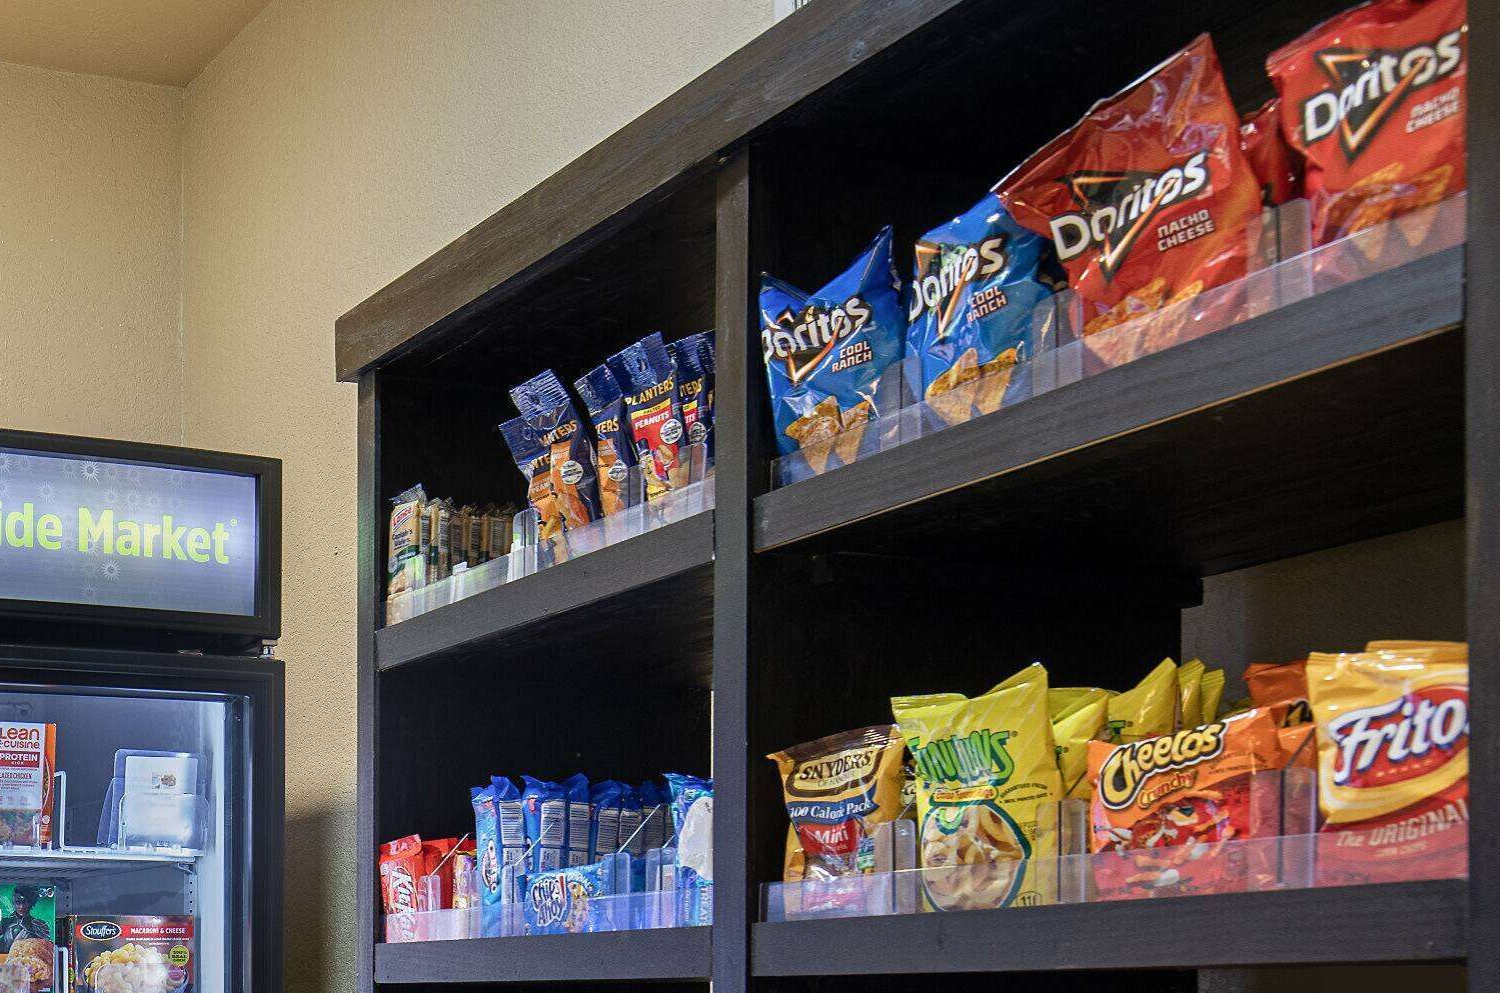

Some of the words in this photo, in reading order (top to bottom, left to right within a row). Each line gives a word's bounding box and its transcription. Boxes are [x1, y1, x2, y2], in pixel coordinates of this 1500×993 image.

[1304, 31, 1462, 143] Doritos
[1406, 101, 1461, 134] CHEESE
[1410, 86, 1460, 119] NACHO
[1048, 150, 1209, 263] Doritos
[1157, 219, 1214, 252] CHEESE
[1158, 208, 1209, 239] NACHO
[909, 237, 1005, 322] Doritos
[966, 294, 1007, 324] RANCH
[970, 285, 1004, 307] COOL
[761, 297, 870, 358] Doritos
[831, 351, 872, 373] RANCH
[840, 341, 870, 359] COOL
[625, 376, 674, 407] PLANTERS
[634, 412, 670, 431] PEANUTS
[78, 507, 230, 565] Market
[0, 727, 40, 741] Lean
[0, 752, 38, 762] PROTEIN
[1100, 722, 1224, 806] Cheetos
[1138, 767, 1197, 808] Crunchy
[789, 806, 809, 818] 100
[845, 800, 873, 815] Pack
[814, 825, 849, 844] Mini
[1336, 829, 1363, 848] The
[85, 923, 118, 938] Stouffer's
[130, 927, 160, 935] MACARONI
